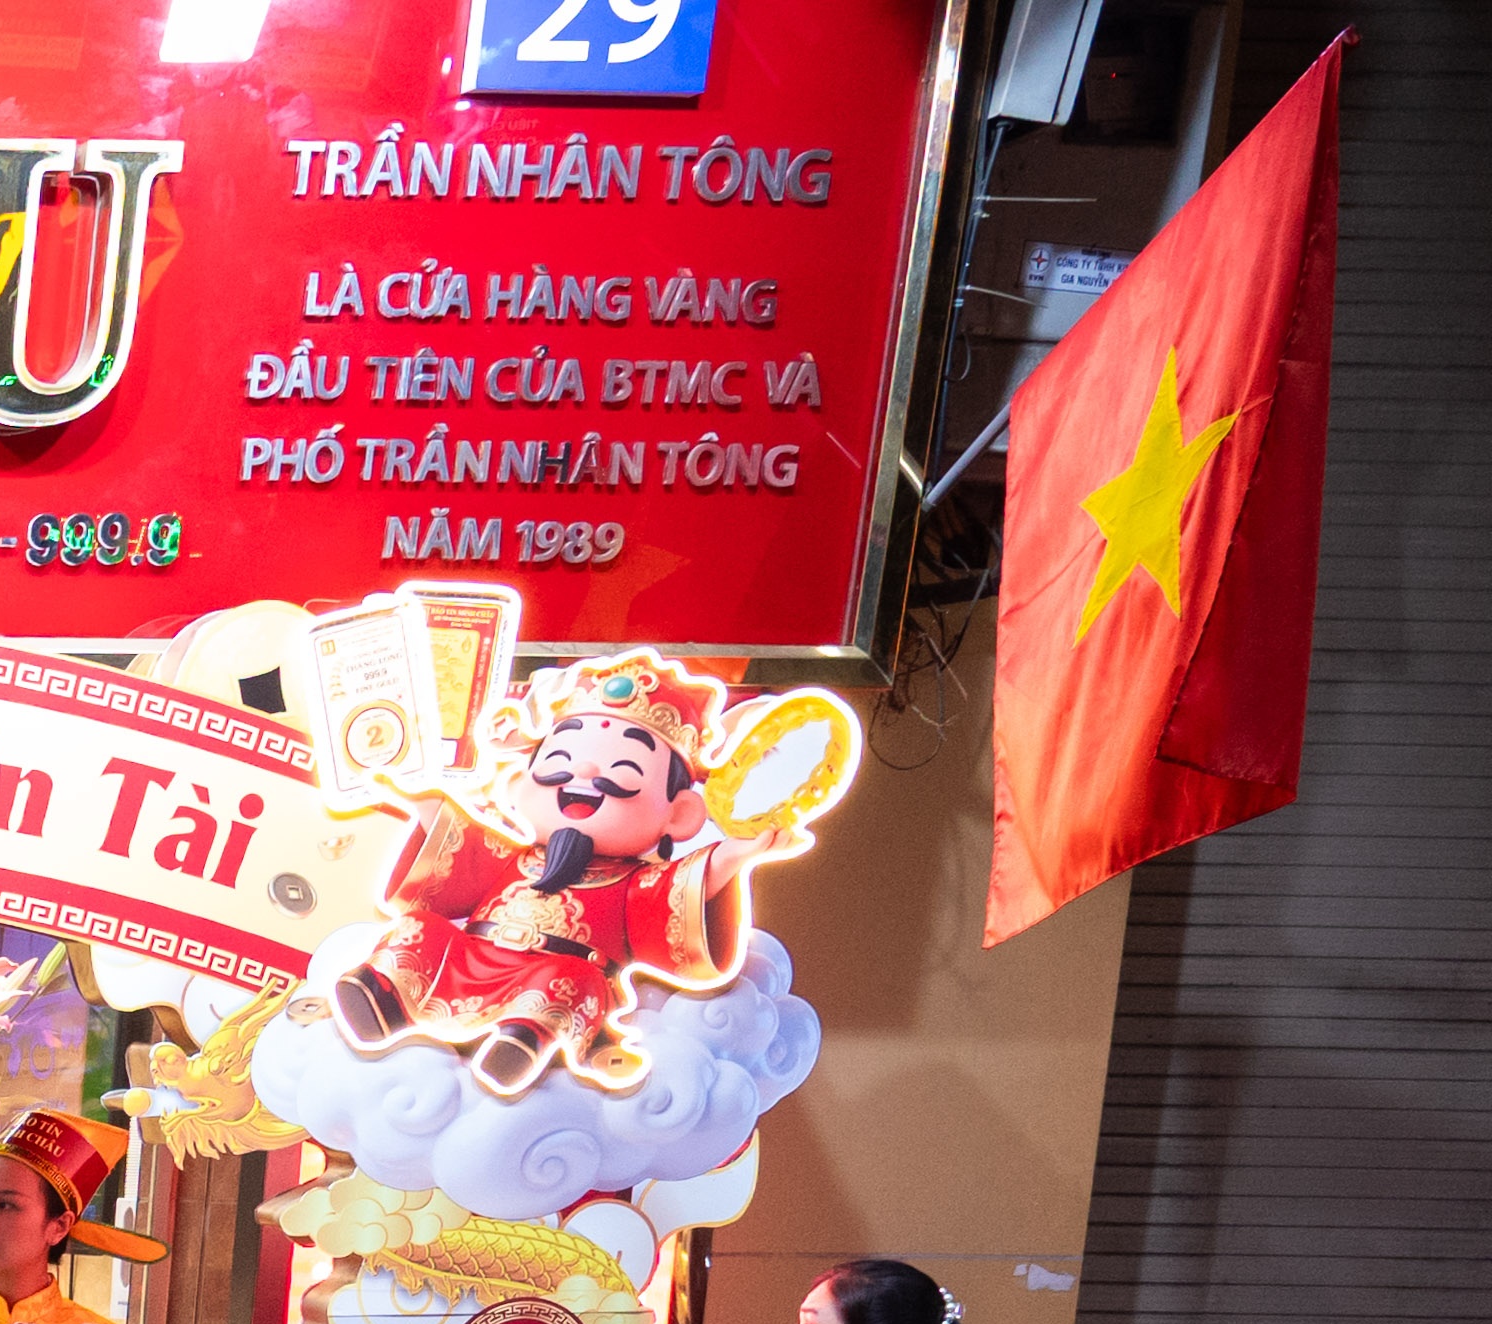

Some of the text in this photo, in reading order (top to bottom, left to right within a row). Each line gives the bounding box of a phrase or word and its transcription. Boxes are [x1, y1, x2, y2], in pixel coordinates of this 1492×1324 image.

[515, 0, 681, 63] 29
[287, 122, 831, 204] TRẦN NHÂN TÔNG
[304, 257, 779, 324] LÀ CỬA HÀNG VÀNG
[245, 338, 822, 408] ĐẦU TIÊN CỦA BTMC VÀ
[241, 422, 801, 489] PHỐ TRẦN NHÂN TÔNG
[27, 511, 182, 568] 999.9
[383, 509, 625, 564] NĂM 1989
[99, 755, 268, 891] Tài
[26, 1130, 66, 1158] CHÂU
[41, 1118, 64, 1139] TÍN
